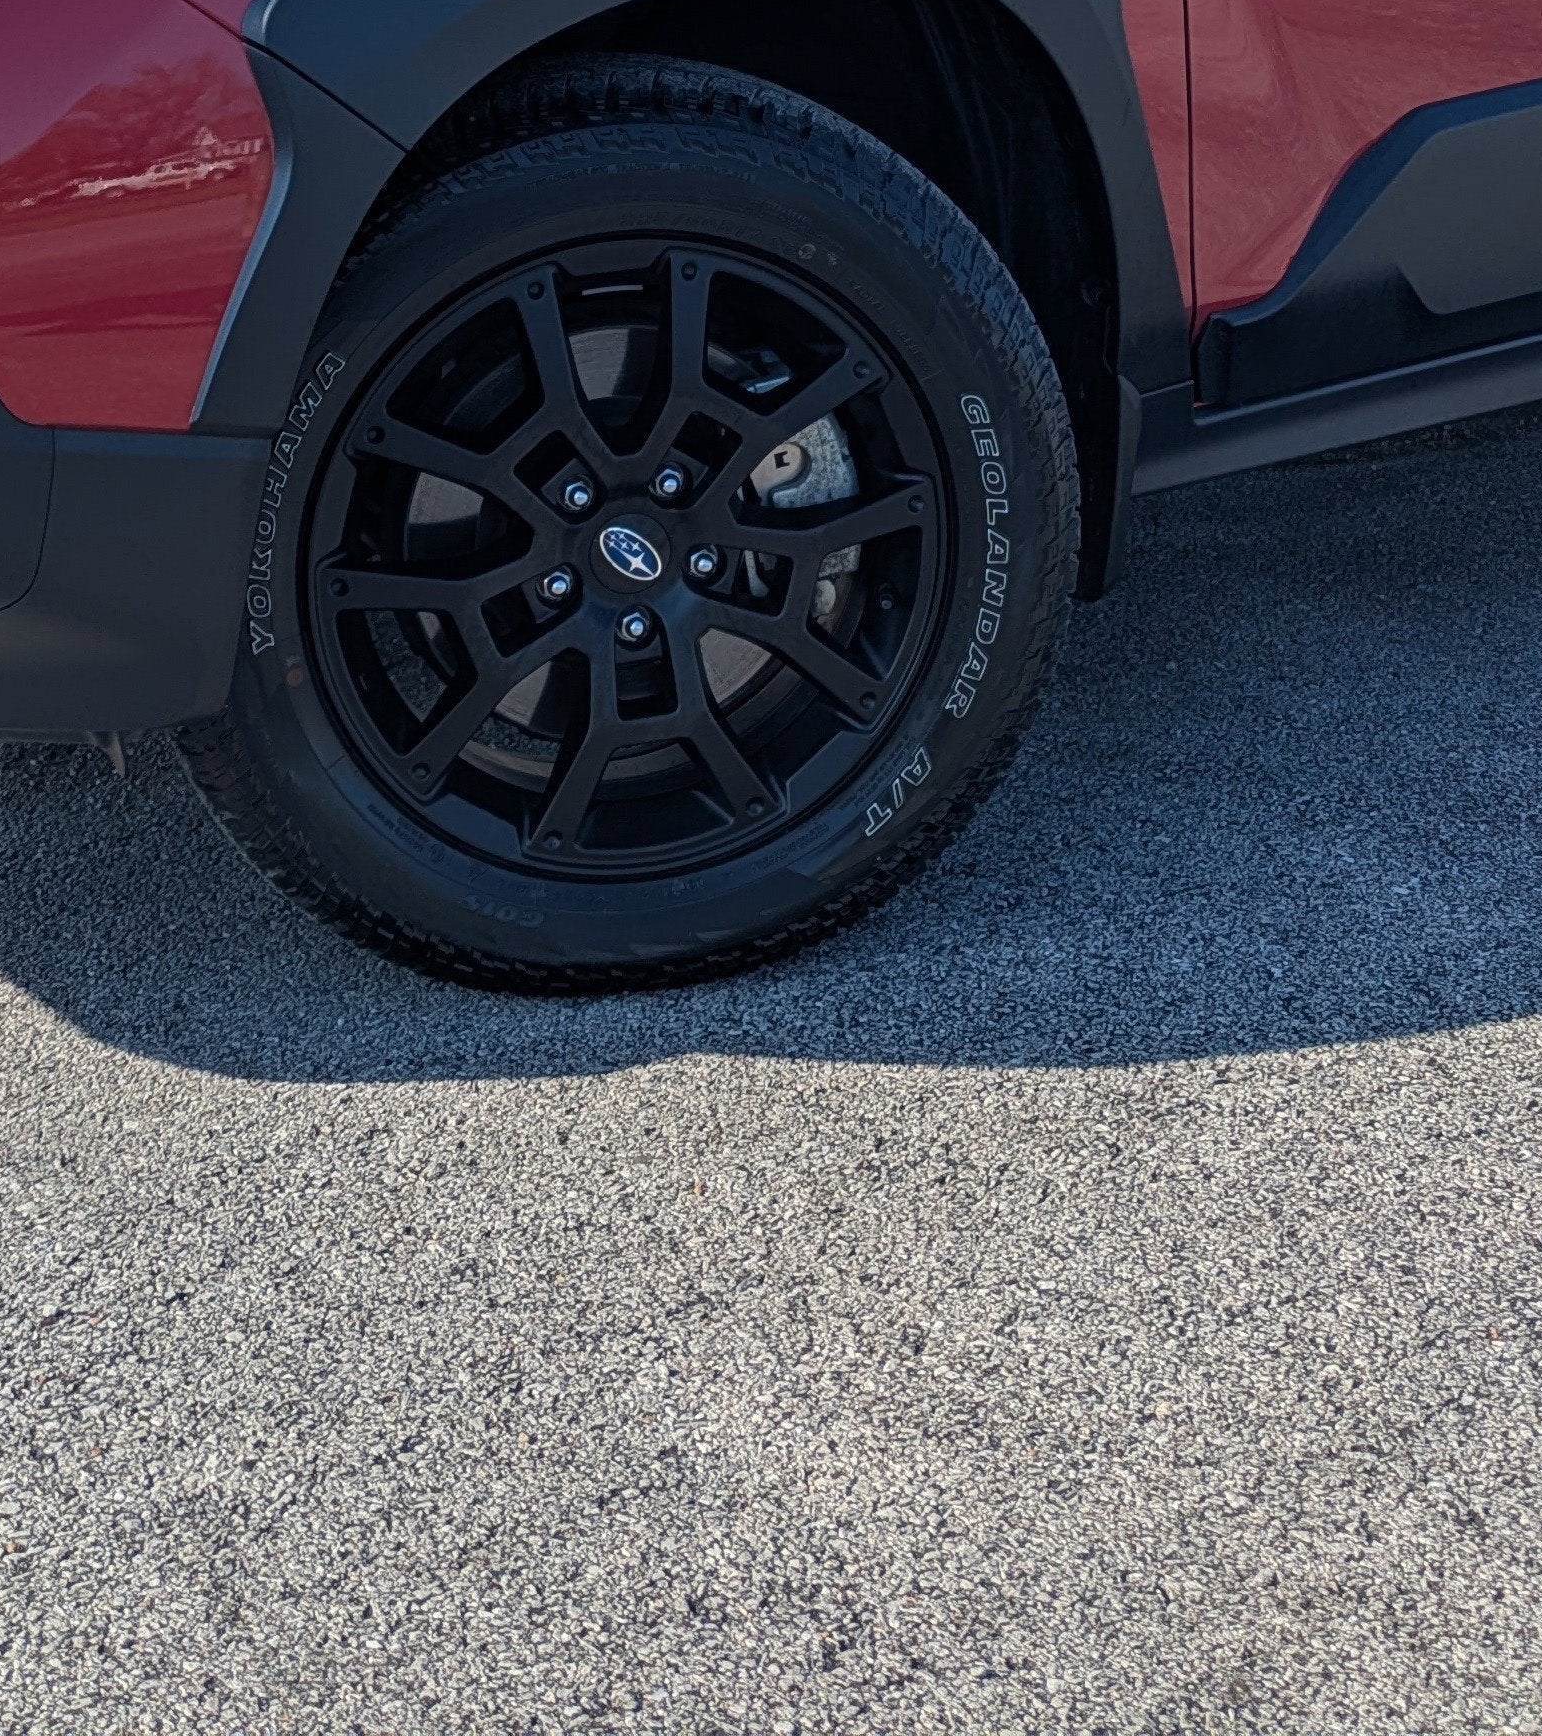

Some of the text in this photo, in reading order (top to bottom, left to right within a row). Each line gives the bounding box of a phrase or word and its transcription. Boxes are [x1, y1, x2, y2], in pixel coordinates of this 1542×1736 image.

[246, 352, 346, 655] YOKOHAMA
[945, 393, 1011, 720] GEOLANDAR
[864, 746, 933, 838] A/T
